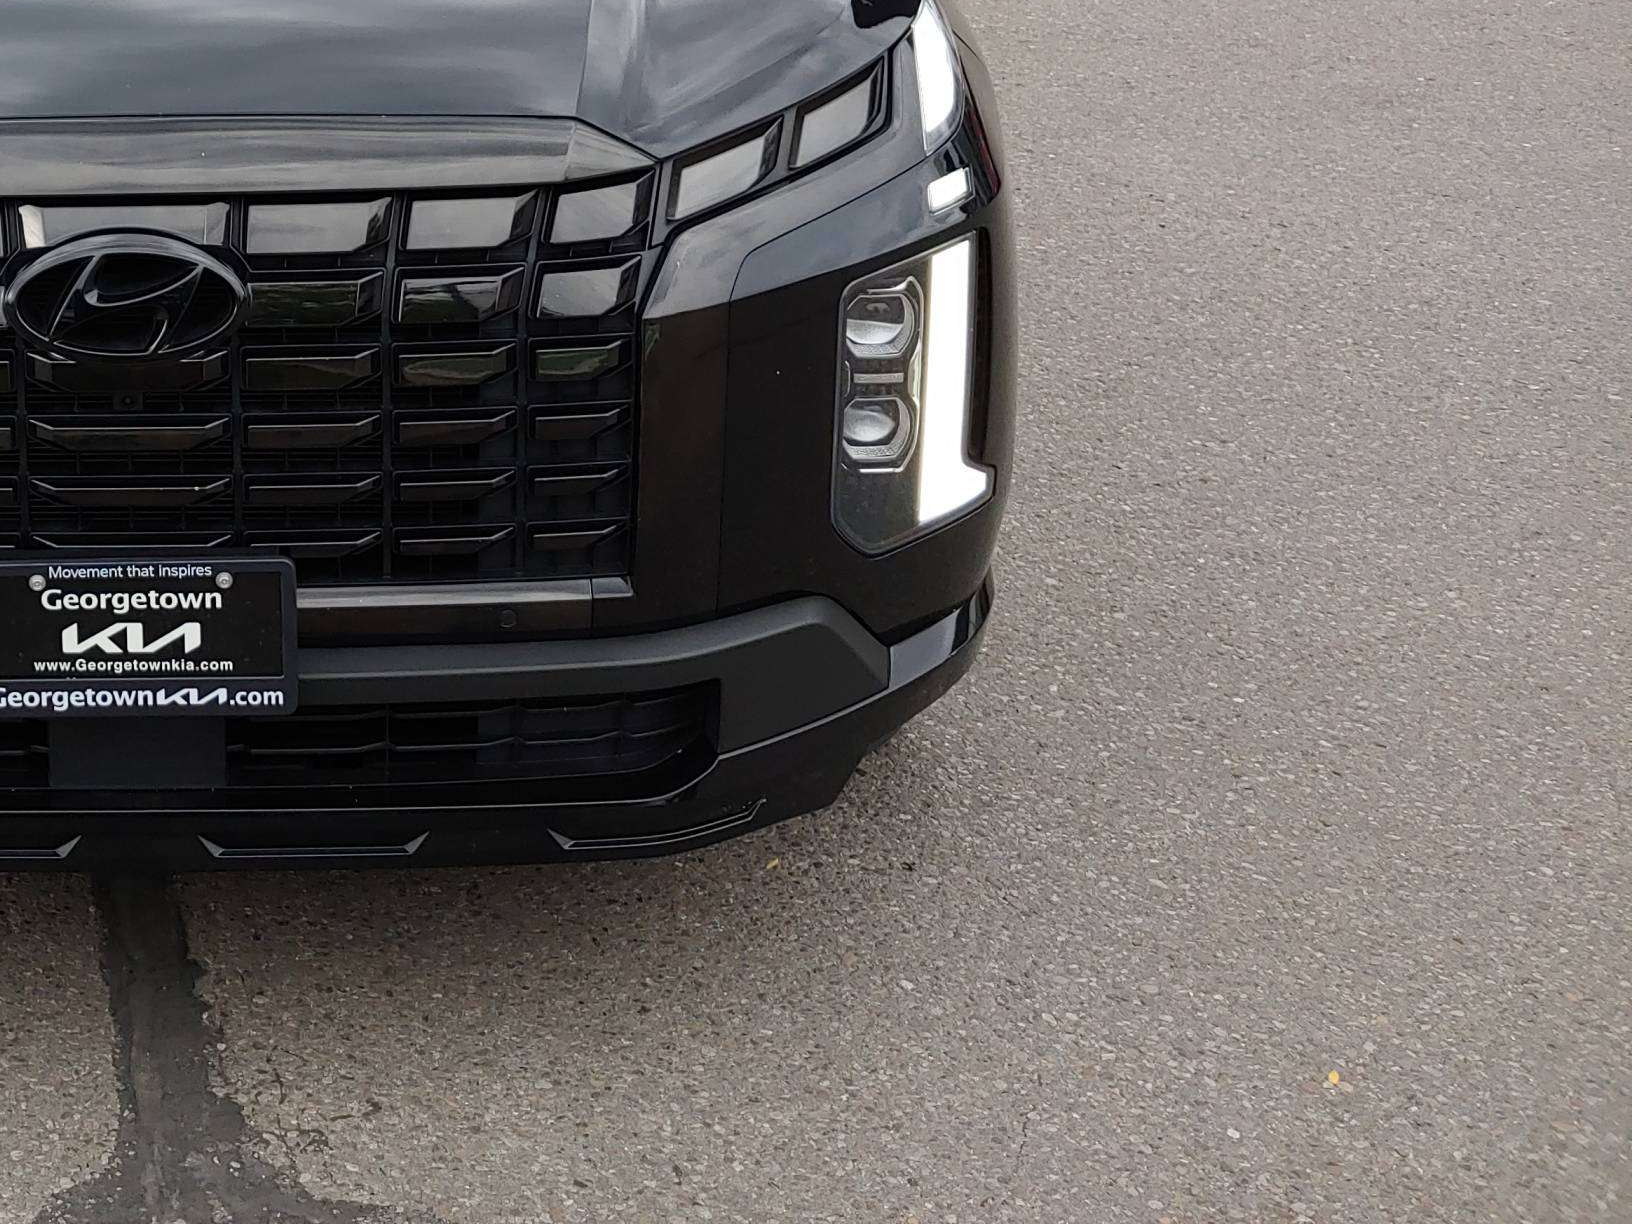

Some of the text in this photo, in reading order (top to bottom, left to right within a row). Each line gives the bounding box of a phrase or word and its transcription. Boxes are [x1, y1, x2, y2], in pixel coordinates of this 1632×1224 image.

[48, 565, 125, 579] Movement
[126, 565, 154, 578] that
[40, 588, 223, 615] Georgetown
[61, 621, 202, 654] KIA
[33, 658, 234, 674] www.Georgetownkia.com
